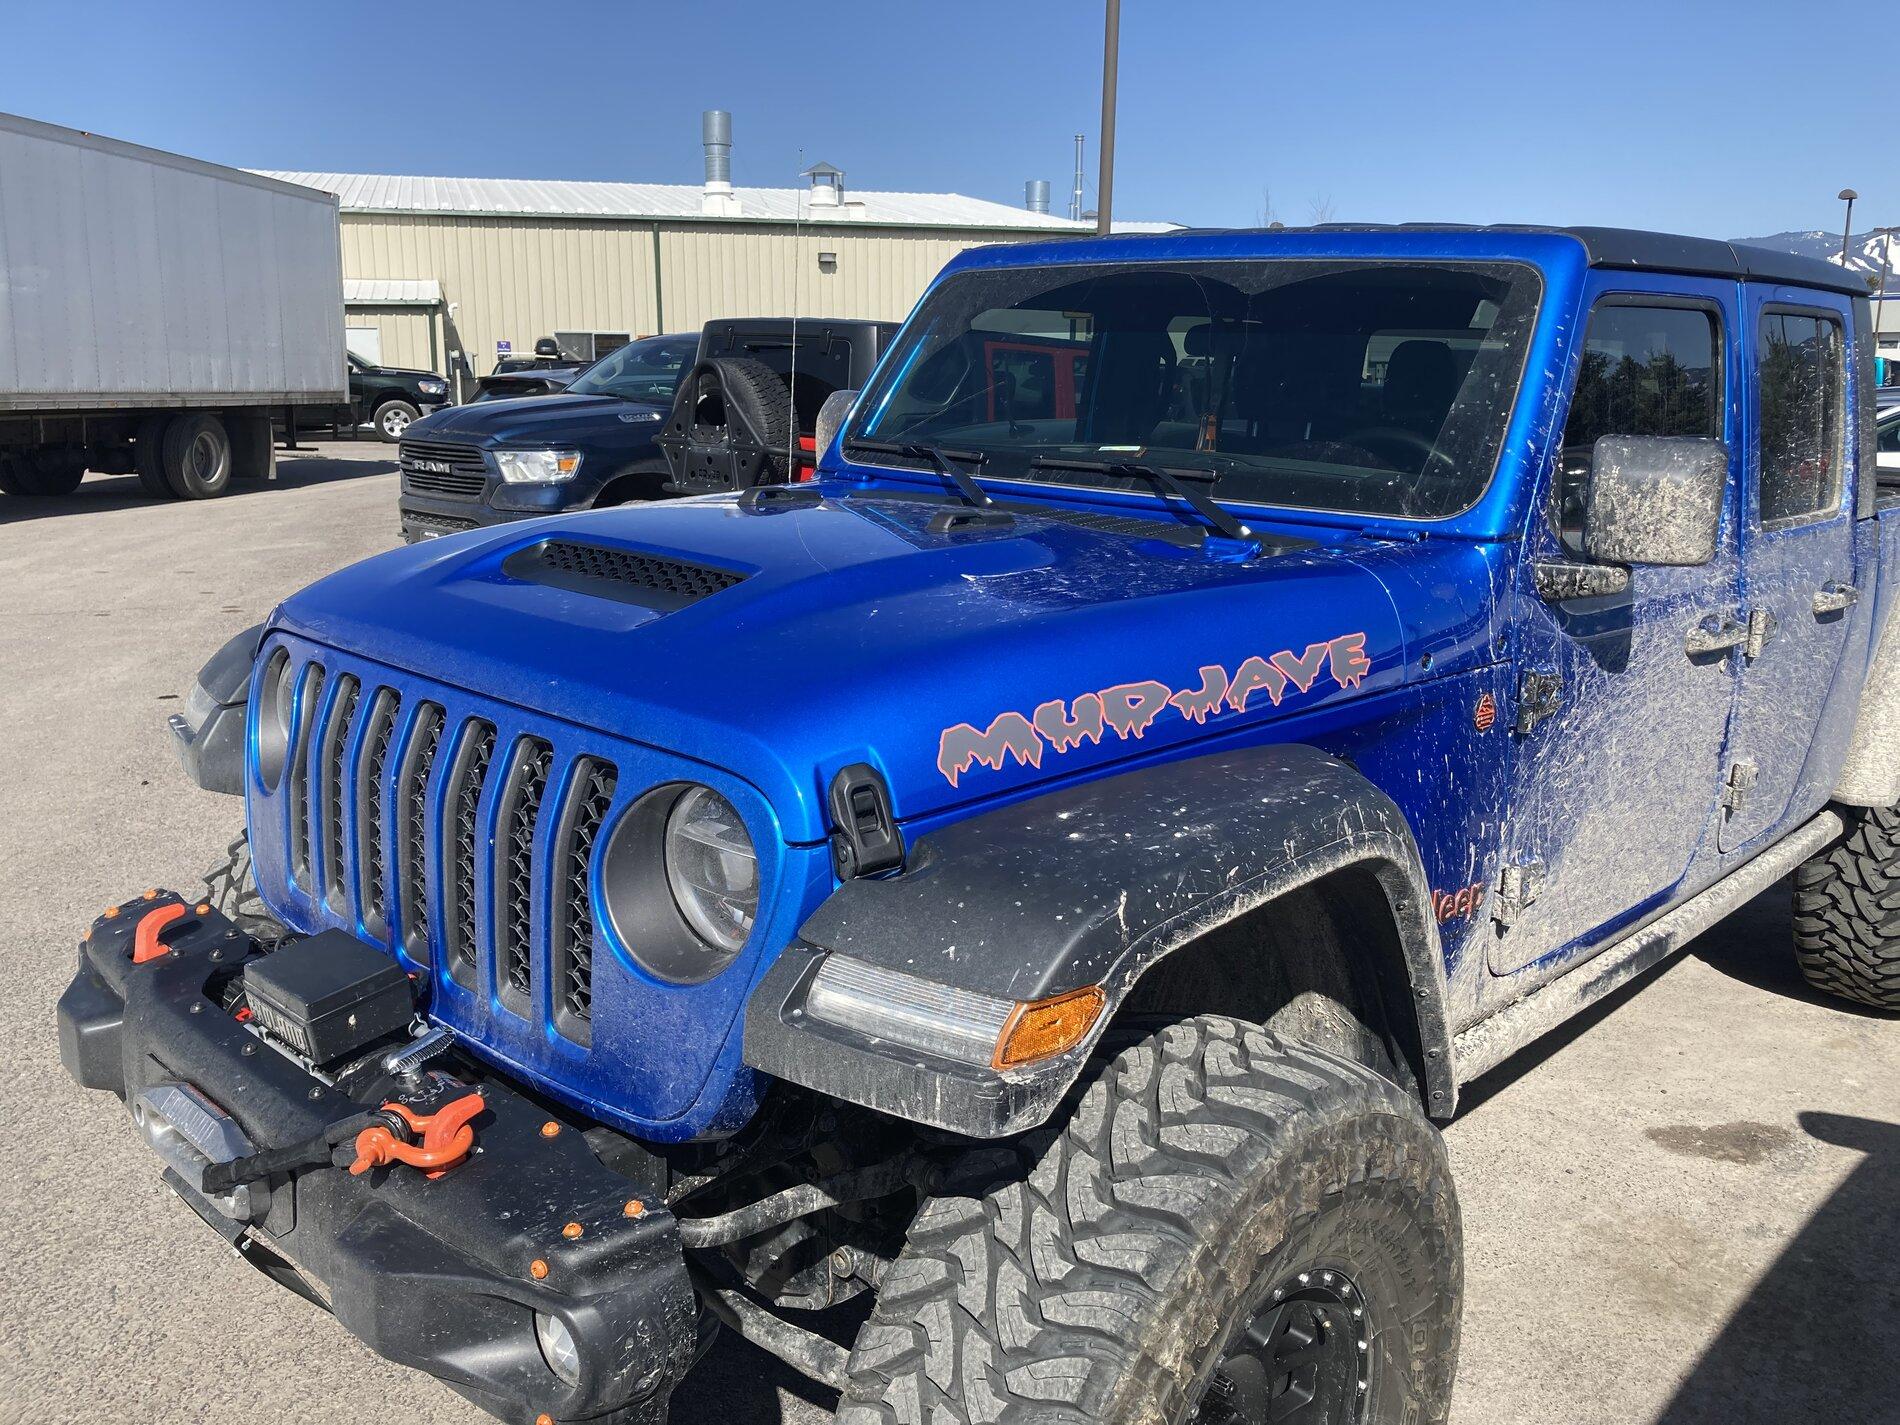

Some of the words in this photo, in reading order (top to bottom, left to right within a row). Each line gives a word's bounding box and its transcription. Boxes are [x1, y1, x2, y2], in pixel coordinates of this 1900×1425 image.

[412, 460, 450, 473] RAM
[937, 632, 1371, 788] MUDJAVE
[1432, 882, 1484, 926] Jeep
